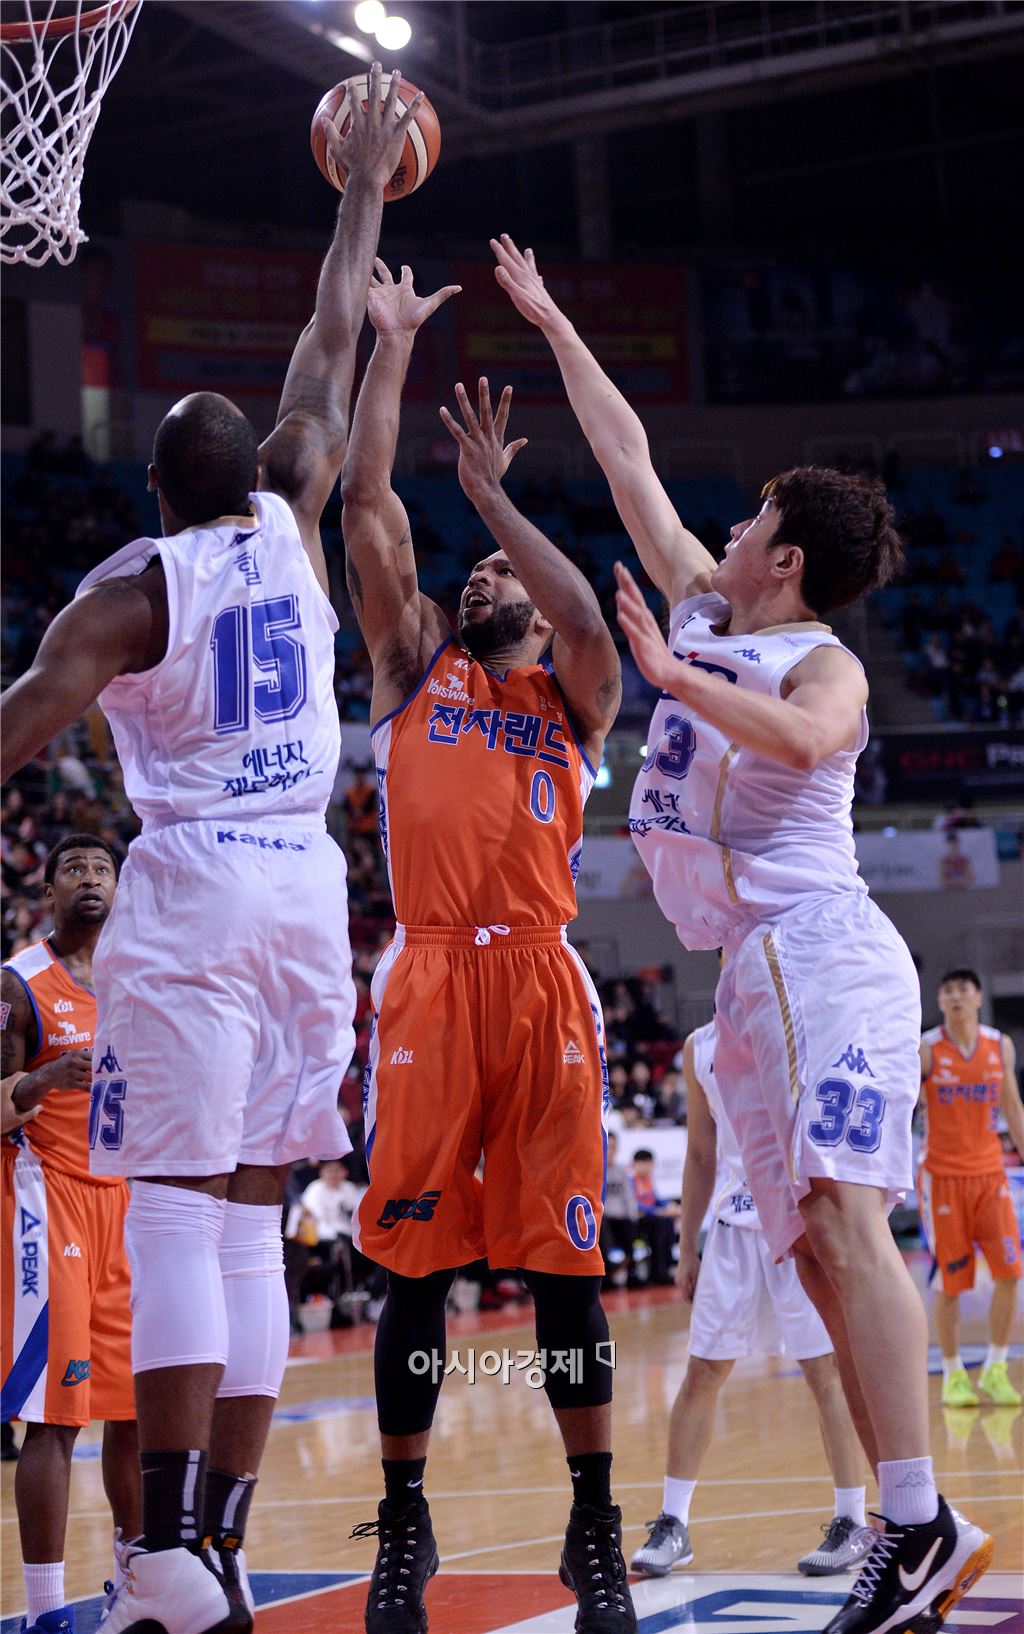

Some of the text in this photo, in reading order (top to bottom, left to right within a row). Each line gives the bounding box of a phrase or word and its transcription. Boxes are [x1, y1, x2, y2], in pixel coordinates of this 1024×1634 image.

[233, 549, 262, 586] 힐
[209, 594, 306, 735] 15
[242, 740, 309, 777] 에너지
[428, 703, 570, 769] 전자랜드
[642, 713, 697, 780] 3
[530, 770, 555, 823] 0
[390, 1046, 413, 1064] KBL
[562, 1054, 585, 1064] PEAK
[89, 1079, 127, 1150] 15
[808, 1078, 885, 1154] 33
[565, 1195, 598, 1251] 0
[731, 1194, 755, 1213] 제로
[22, 1241, 39, 1298] PEAK
[1001, 1235, 1017, 1264] 3
